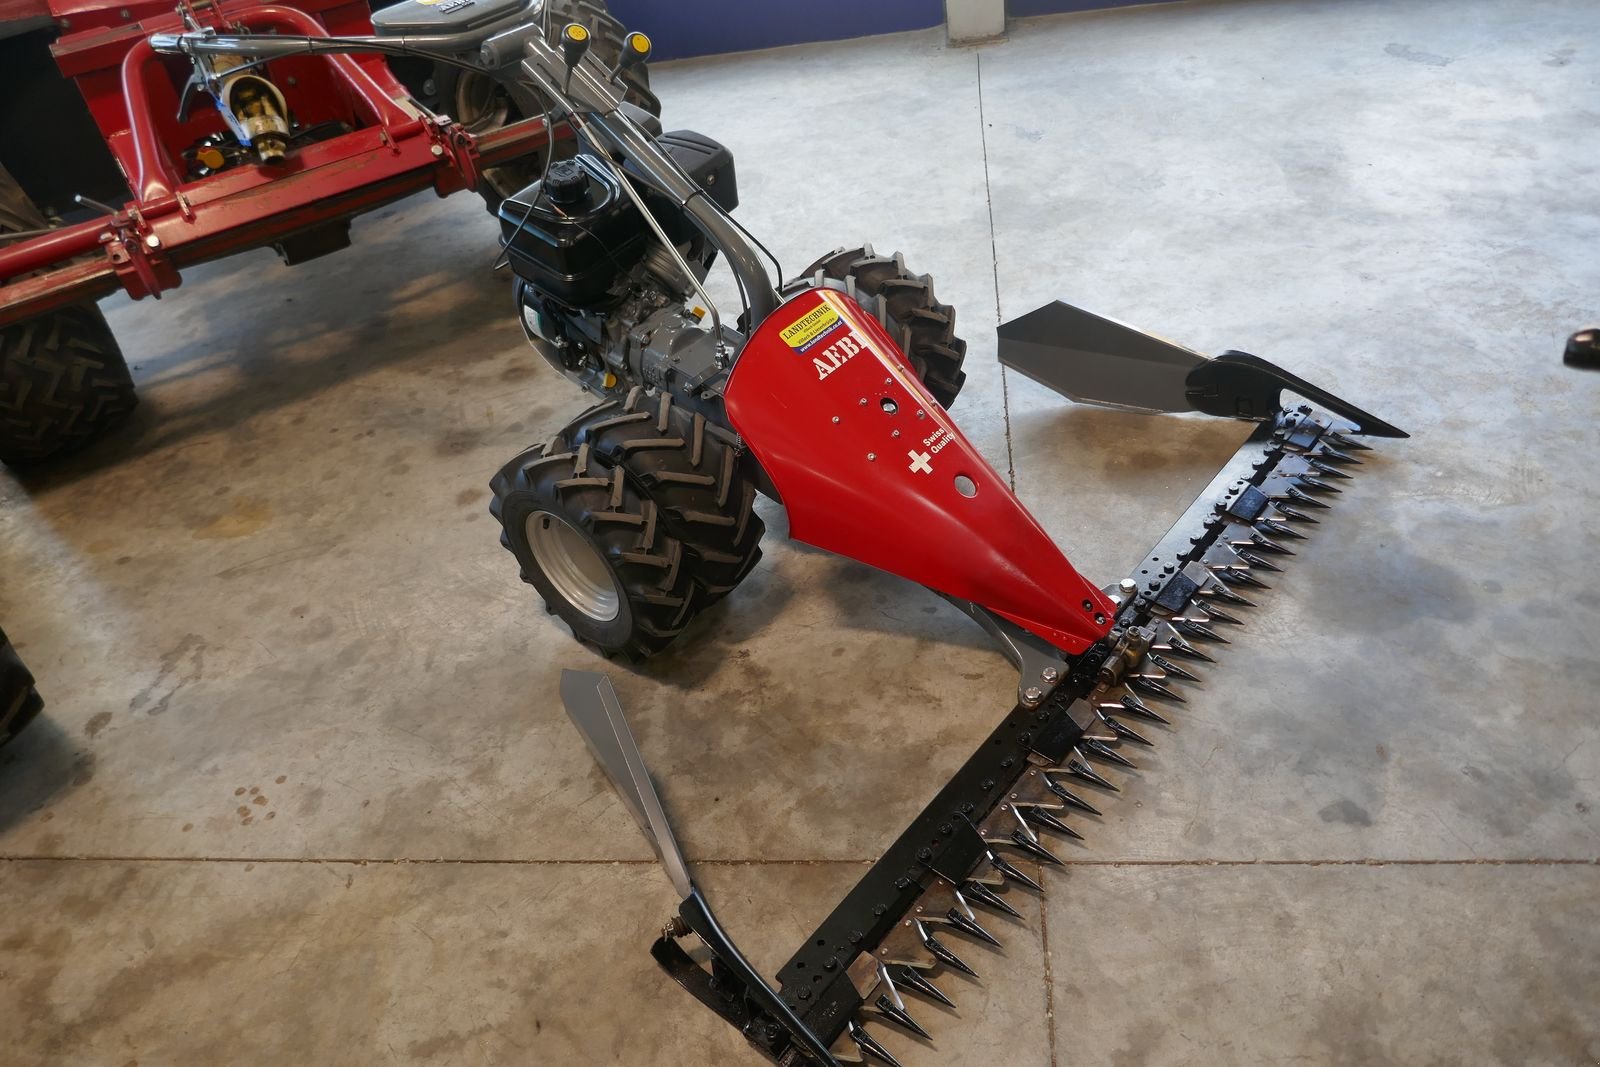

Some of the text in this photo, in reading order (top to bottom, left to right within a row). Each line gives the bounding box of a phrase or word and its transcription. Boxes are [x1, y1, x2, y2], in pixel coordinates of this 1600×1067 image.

[783, 304, 831, 339] LANDTECHNIK
[923, 427, 945, 447] Swiss
[930, 432, 956, 454] Quality
